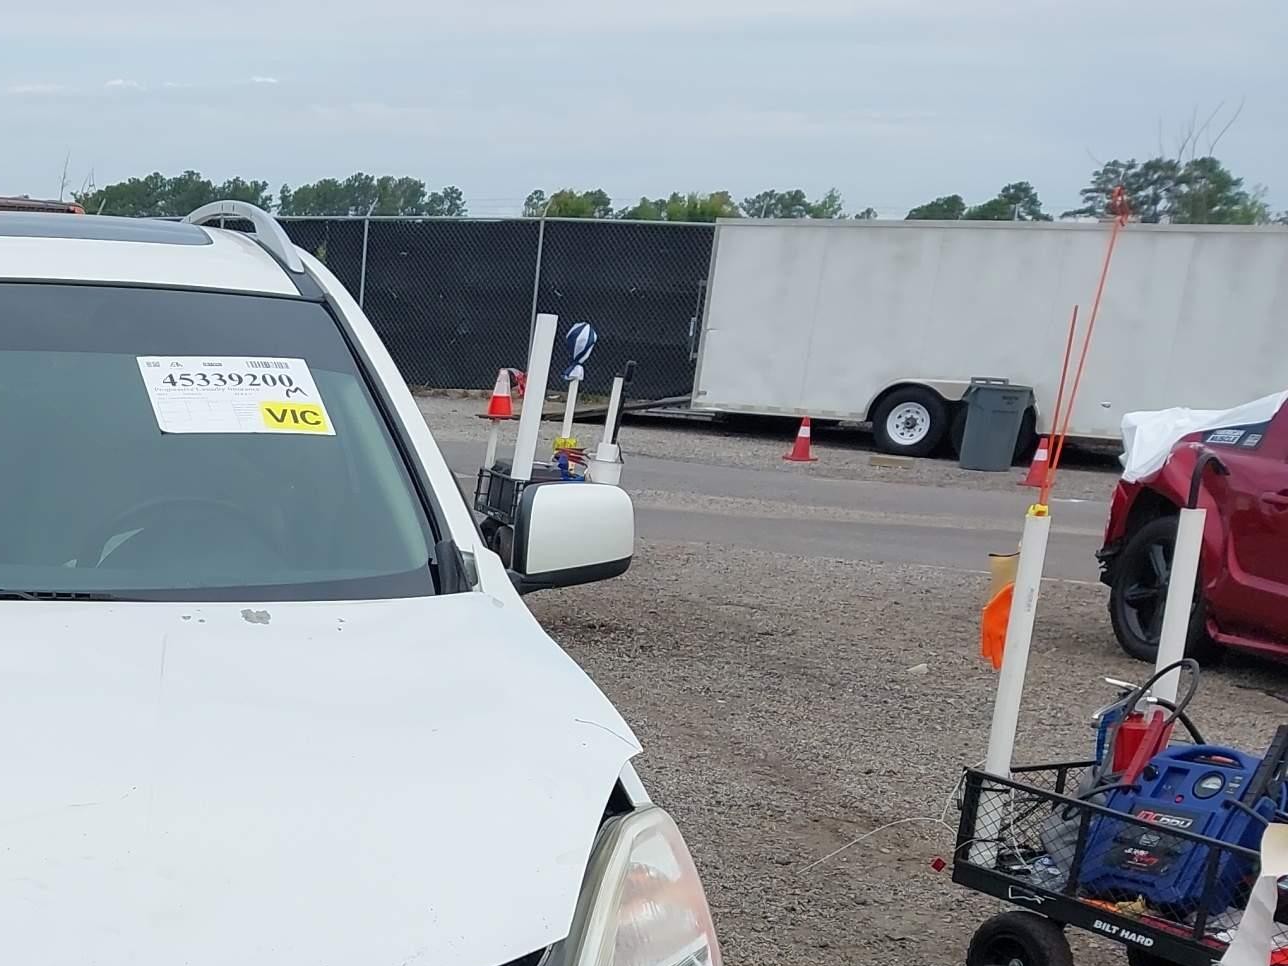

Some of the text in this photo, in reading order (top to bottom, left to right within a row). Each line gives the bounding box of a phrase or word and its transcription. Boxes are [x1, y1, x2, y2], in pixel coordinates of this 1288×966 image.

[162, 372, 294, 388] 45339200
[265, 407, 322, 426] VIC
[1093, 919, 1154, 947] BILT HARD
